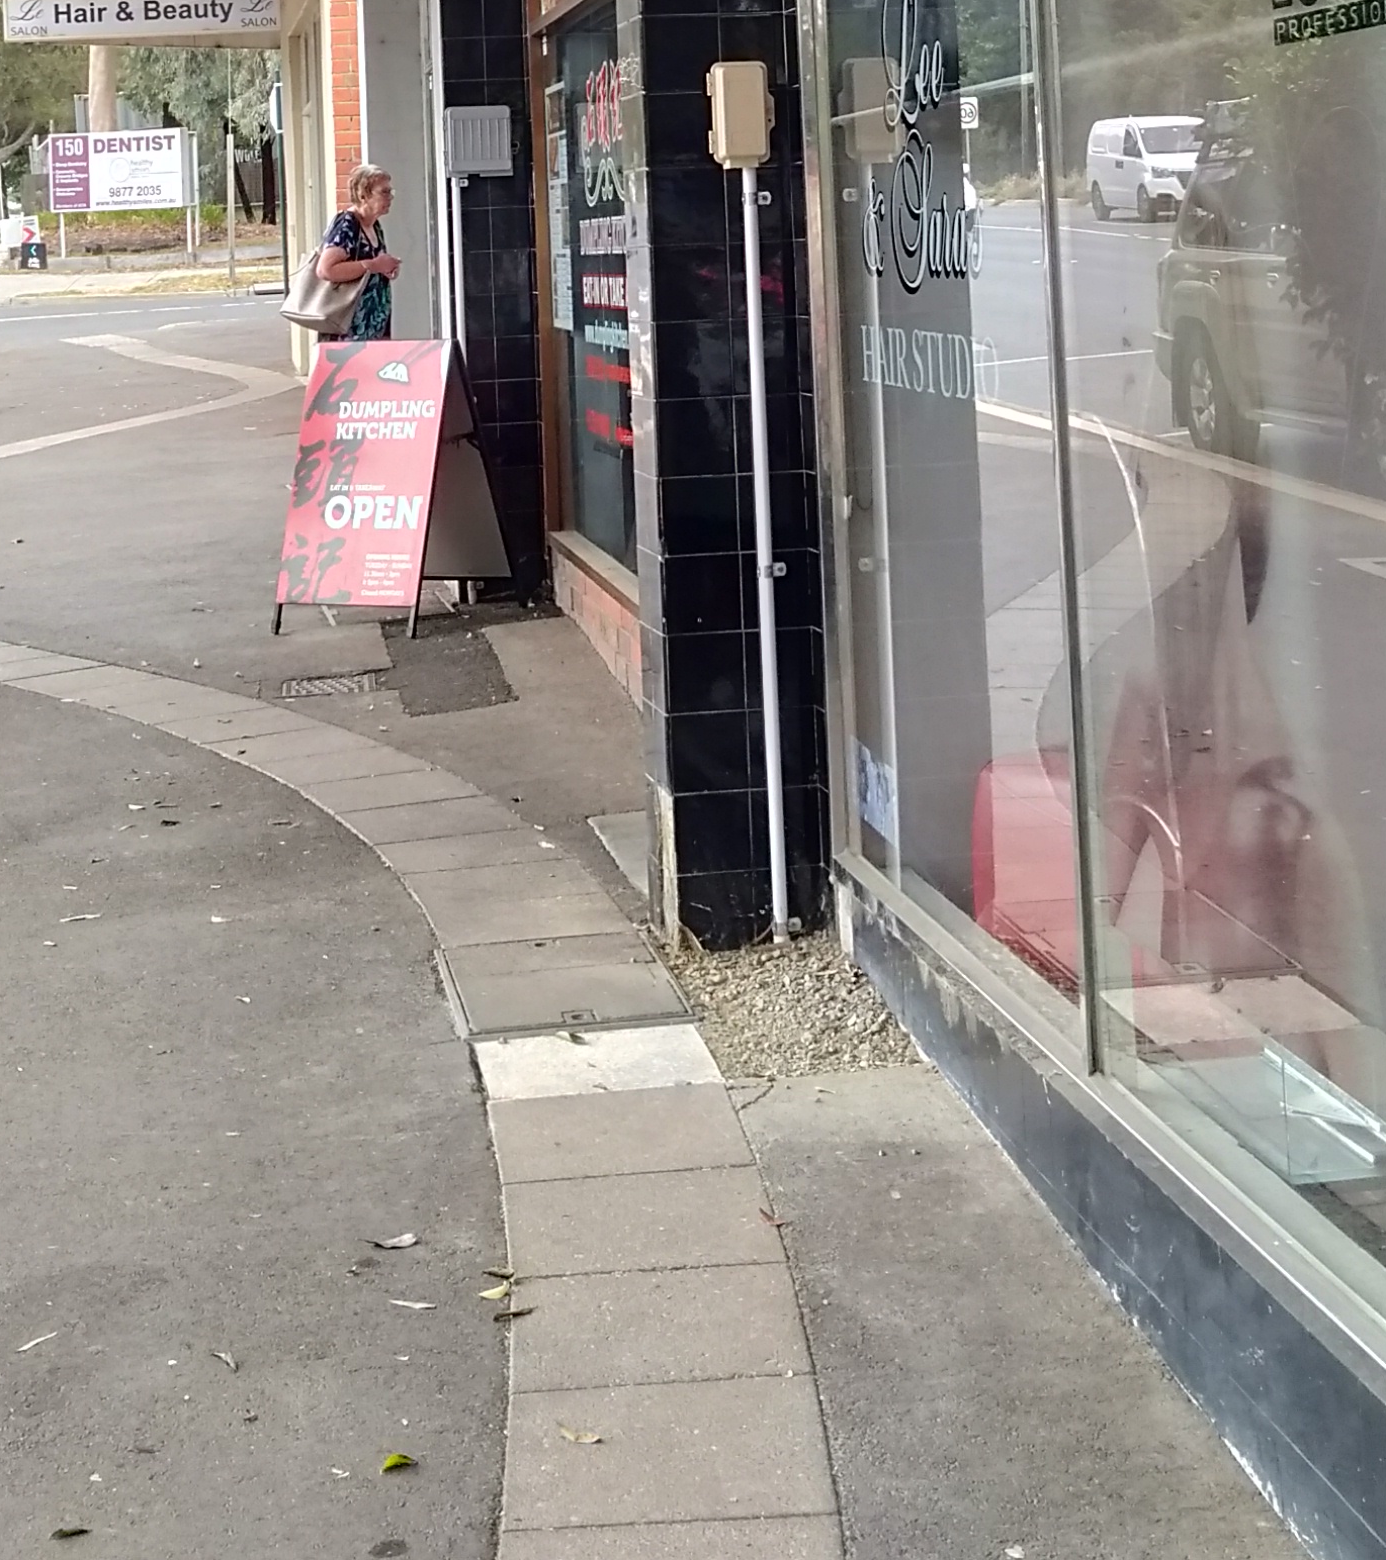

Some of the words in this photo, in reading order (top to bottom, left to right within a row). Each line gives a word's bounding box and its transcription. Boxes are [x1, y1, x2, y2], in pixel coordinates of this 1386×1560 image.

[54, 2, 107, 24] Hair
[115, 1, 134, 22] &
[10, 26, 48, 36] SALON
[241, 17, 277, 28] SALON
[55, 138, 84, 157] 150
[93, 135, 175, 153] DENTIST
[109, 187, 133, 197] 9877
[137, 185, 162, 196] 2035
[860, 324, 911, 389] HAIR
[913, 329, 999, 402] STUDIO
[339, 400, 436, 419] DUMPLING
[336, 421, 418, 440] KITCHEN
[324, 495, 424, 530] OPEN
